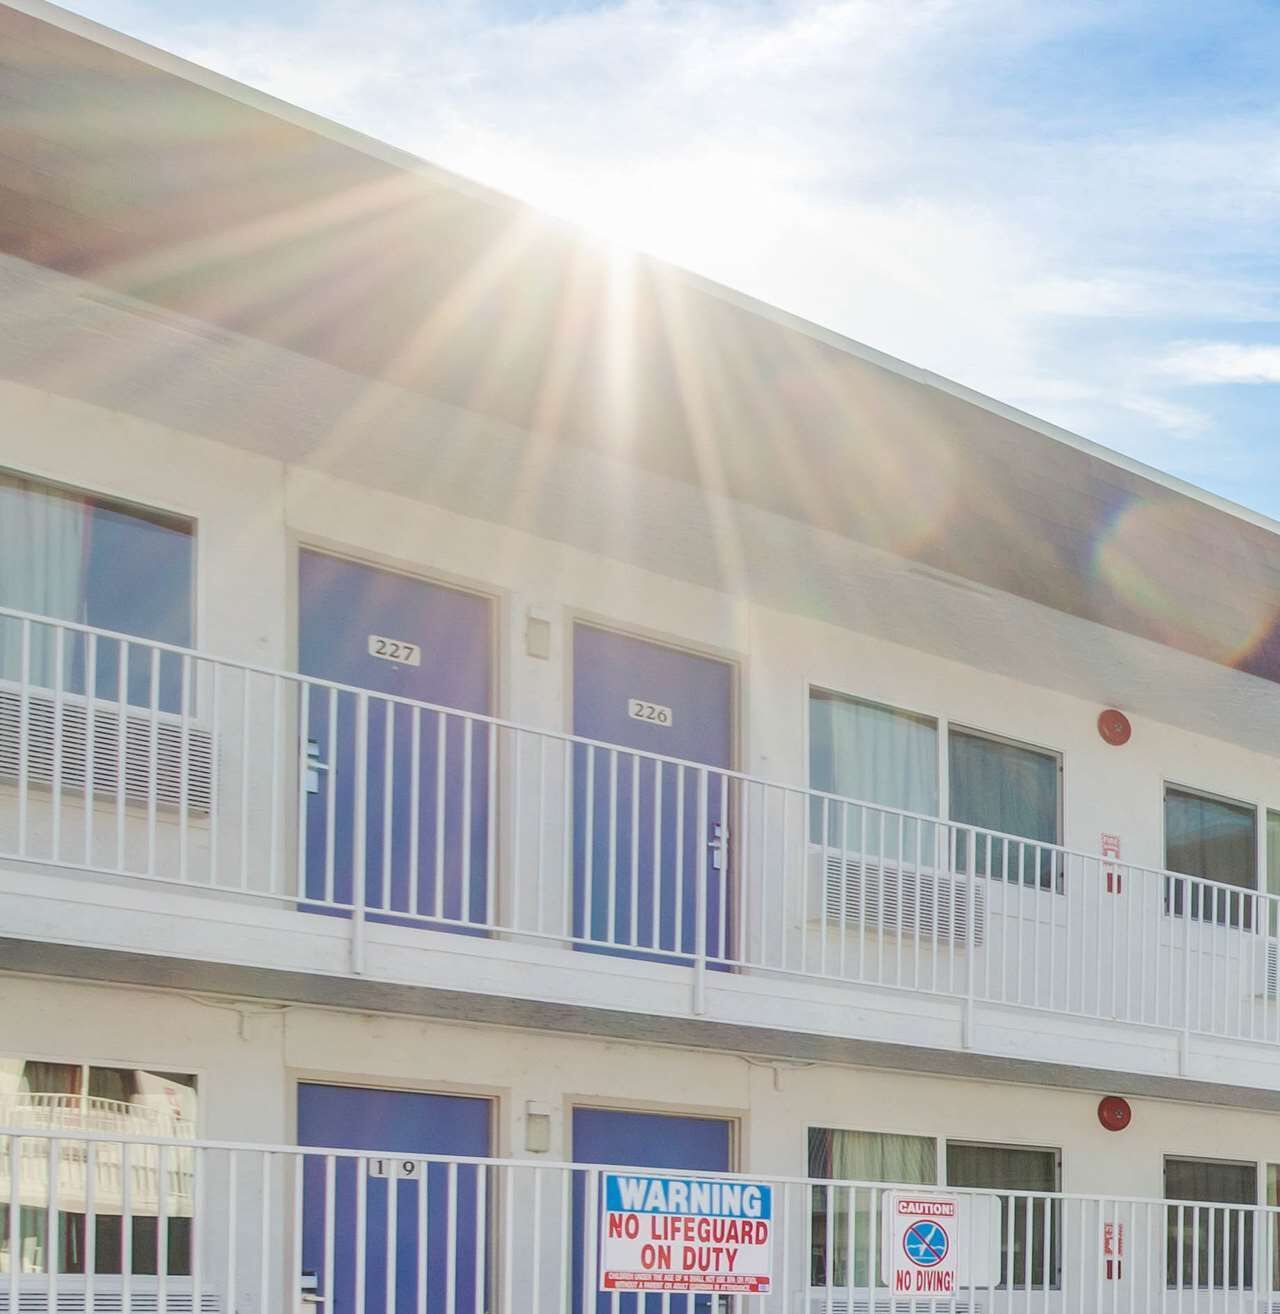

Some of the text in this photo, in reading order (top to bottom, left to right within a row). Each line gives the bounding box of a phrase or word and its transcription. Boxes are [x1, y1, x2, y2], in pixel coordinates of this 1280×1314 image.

[375, 639, 414, 661] 227
[634, 703, 668, 724] 226
[377, 1160, 415, 1175] 19
[617, 1177, 762, 1217] WARNING
[899, 1201, 953, 1215] CAUTION!
[608, 1213, 769, 1246] NO LIFEGUARD
[641, 1243, 738, 1272] ON DUTY
[896, 1269, 954, 1292] NO DIVING!
